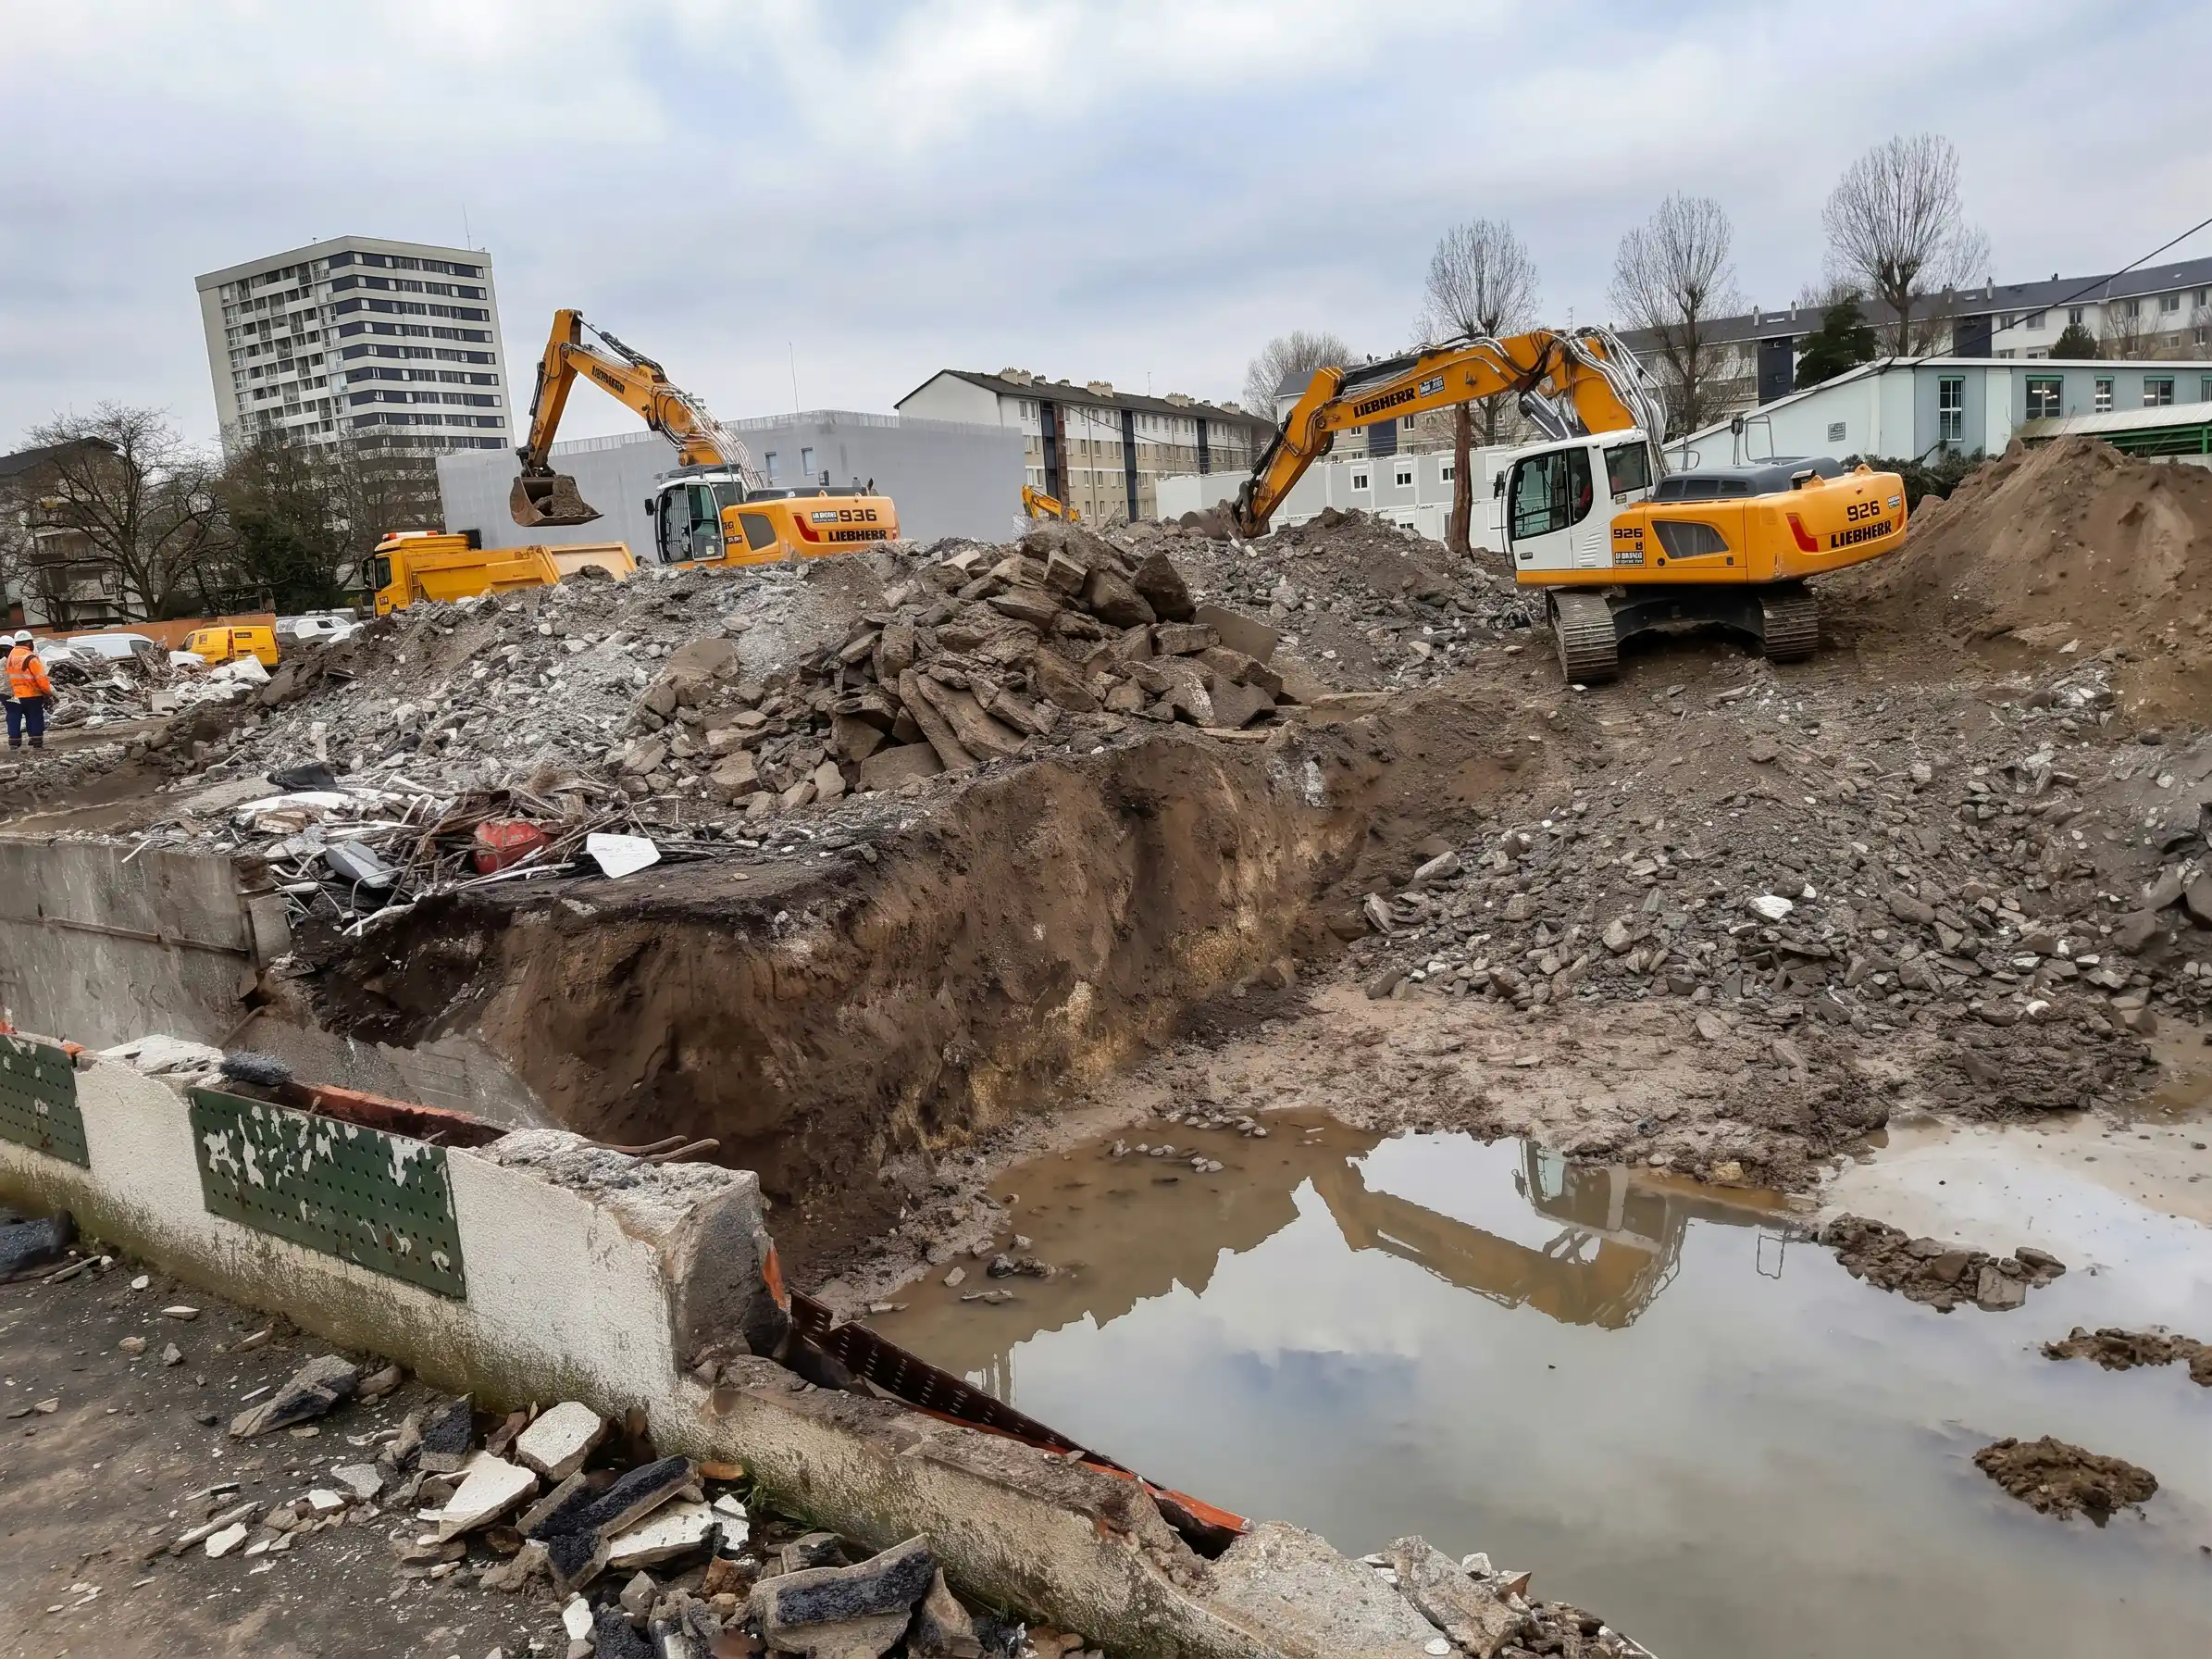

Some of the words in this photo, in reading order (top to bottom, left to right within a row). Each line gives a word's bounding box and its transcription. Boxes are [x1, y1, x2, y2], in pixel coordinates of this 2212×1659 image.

[1353, 387, 1416, 418] LIEBHERR
[839, 509, 877, 522] 936
[1846, 500, 1881, 522] 926
[1613, 528, 1644, 539] 926
[1831, 519, 1892, 548] LIEBHERR
